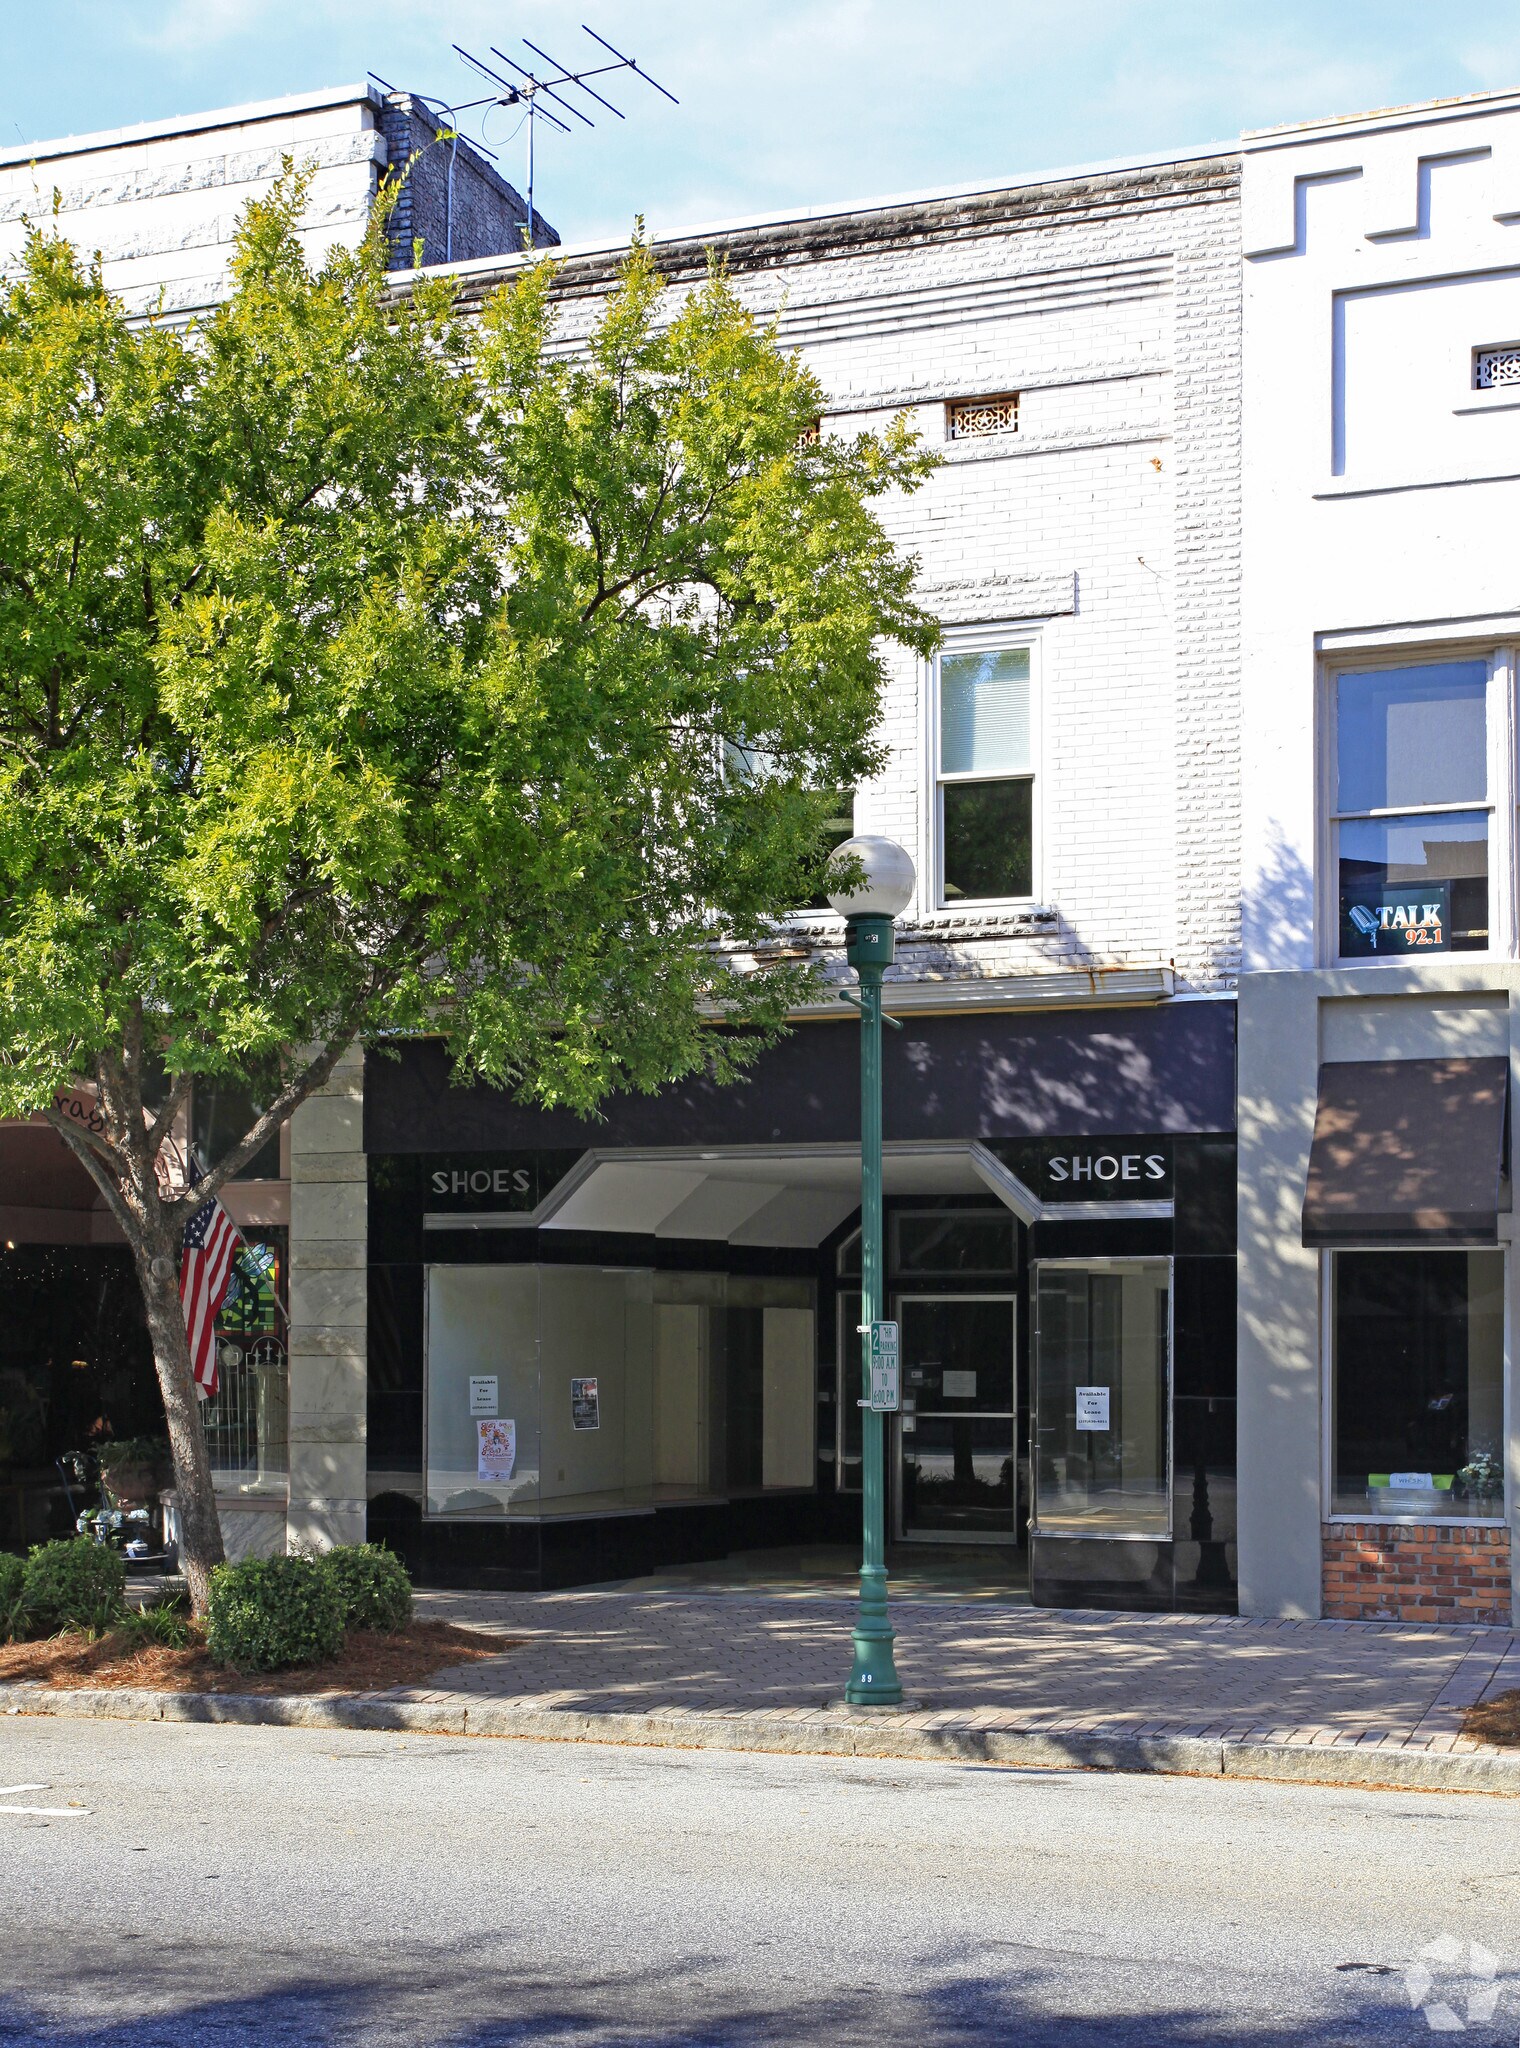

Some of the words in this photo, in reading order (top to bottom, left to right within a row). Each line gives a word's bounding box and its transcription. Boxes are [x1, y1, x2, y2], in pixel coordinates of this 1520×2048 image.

[1375, 904, 1442, 930] TALK
[1405, 928, 1443, 945] 92.1
[1048, 1154, 1166, 1181] SHOES
[431, 1169, 530, 1194] SHOES
[872, 1328, 879, 1351] 2
[880, 1341, 897, 1352] PARKING
[882, 1373, 888, 1387] TO
[861, 1674, 872, 1683] 89
